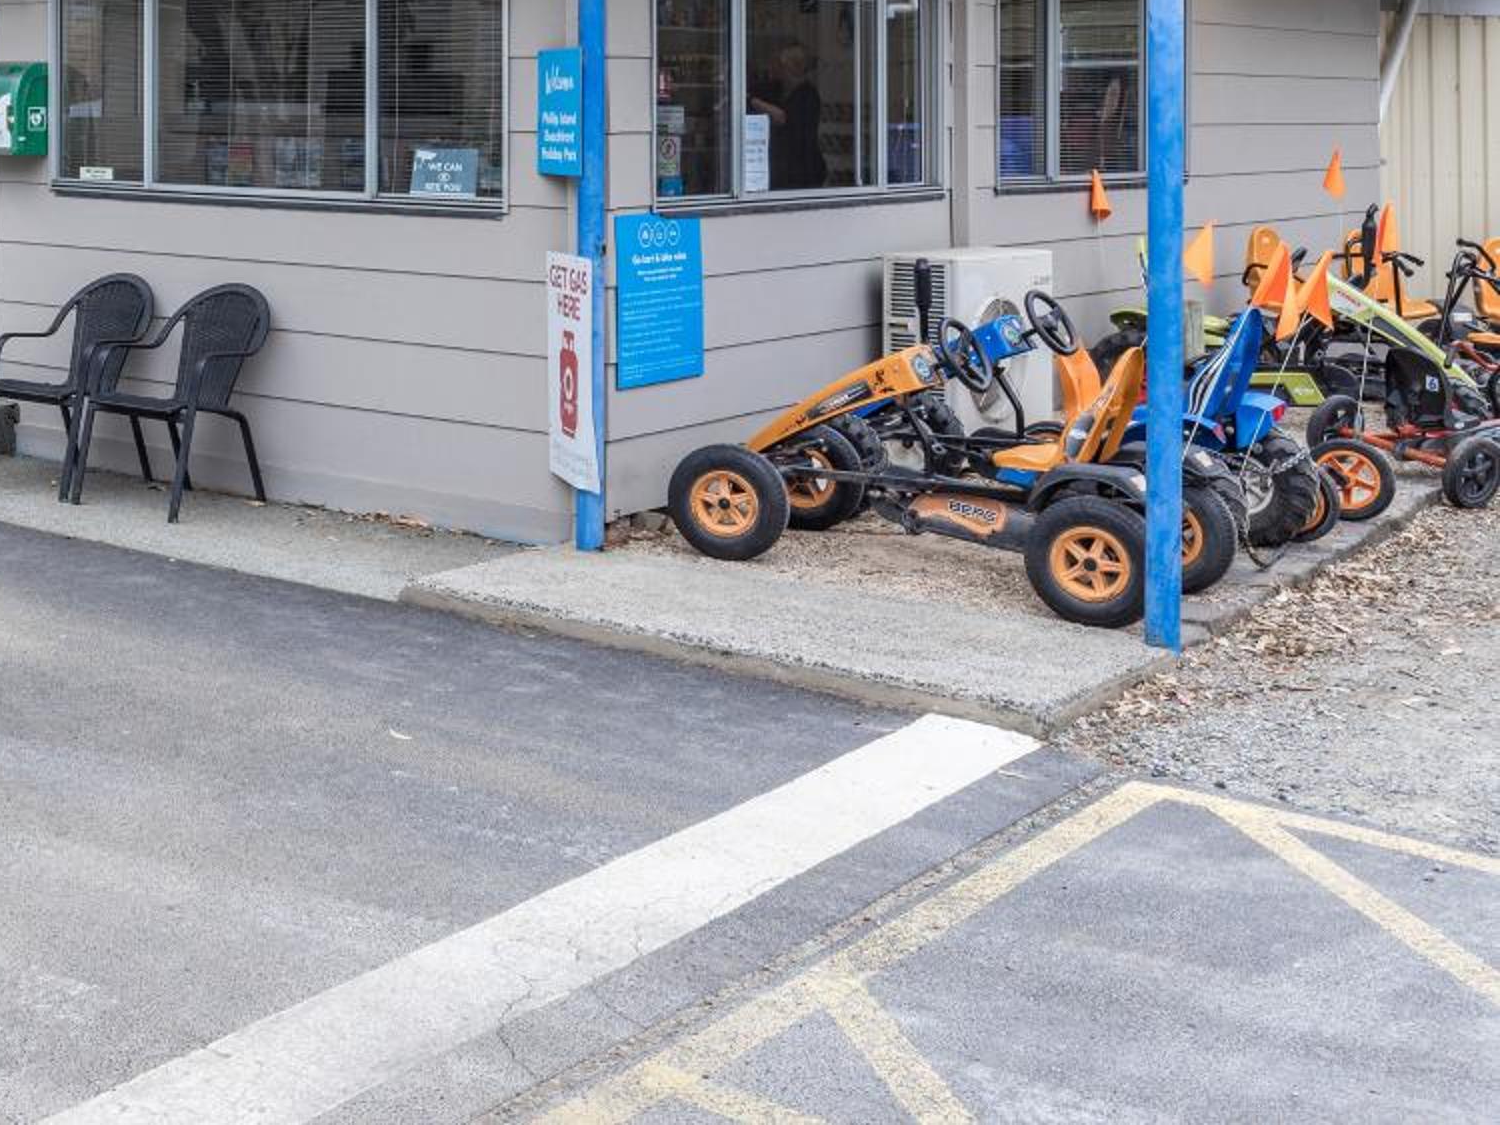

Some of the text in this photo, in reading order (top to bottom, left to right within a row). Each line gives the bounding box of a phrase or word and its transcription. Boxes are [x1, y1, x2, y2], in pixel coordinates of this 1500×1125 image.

[428, 162, 463, 172] WE CAN
[549, 264, 587, 295] GET GAS
[557, 293, 581, 321] HERE
[1428, 376, 1438, 390] 6
[947, 499, 997, 524] BERG
